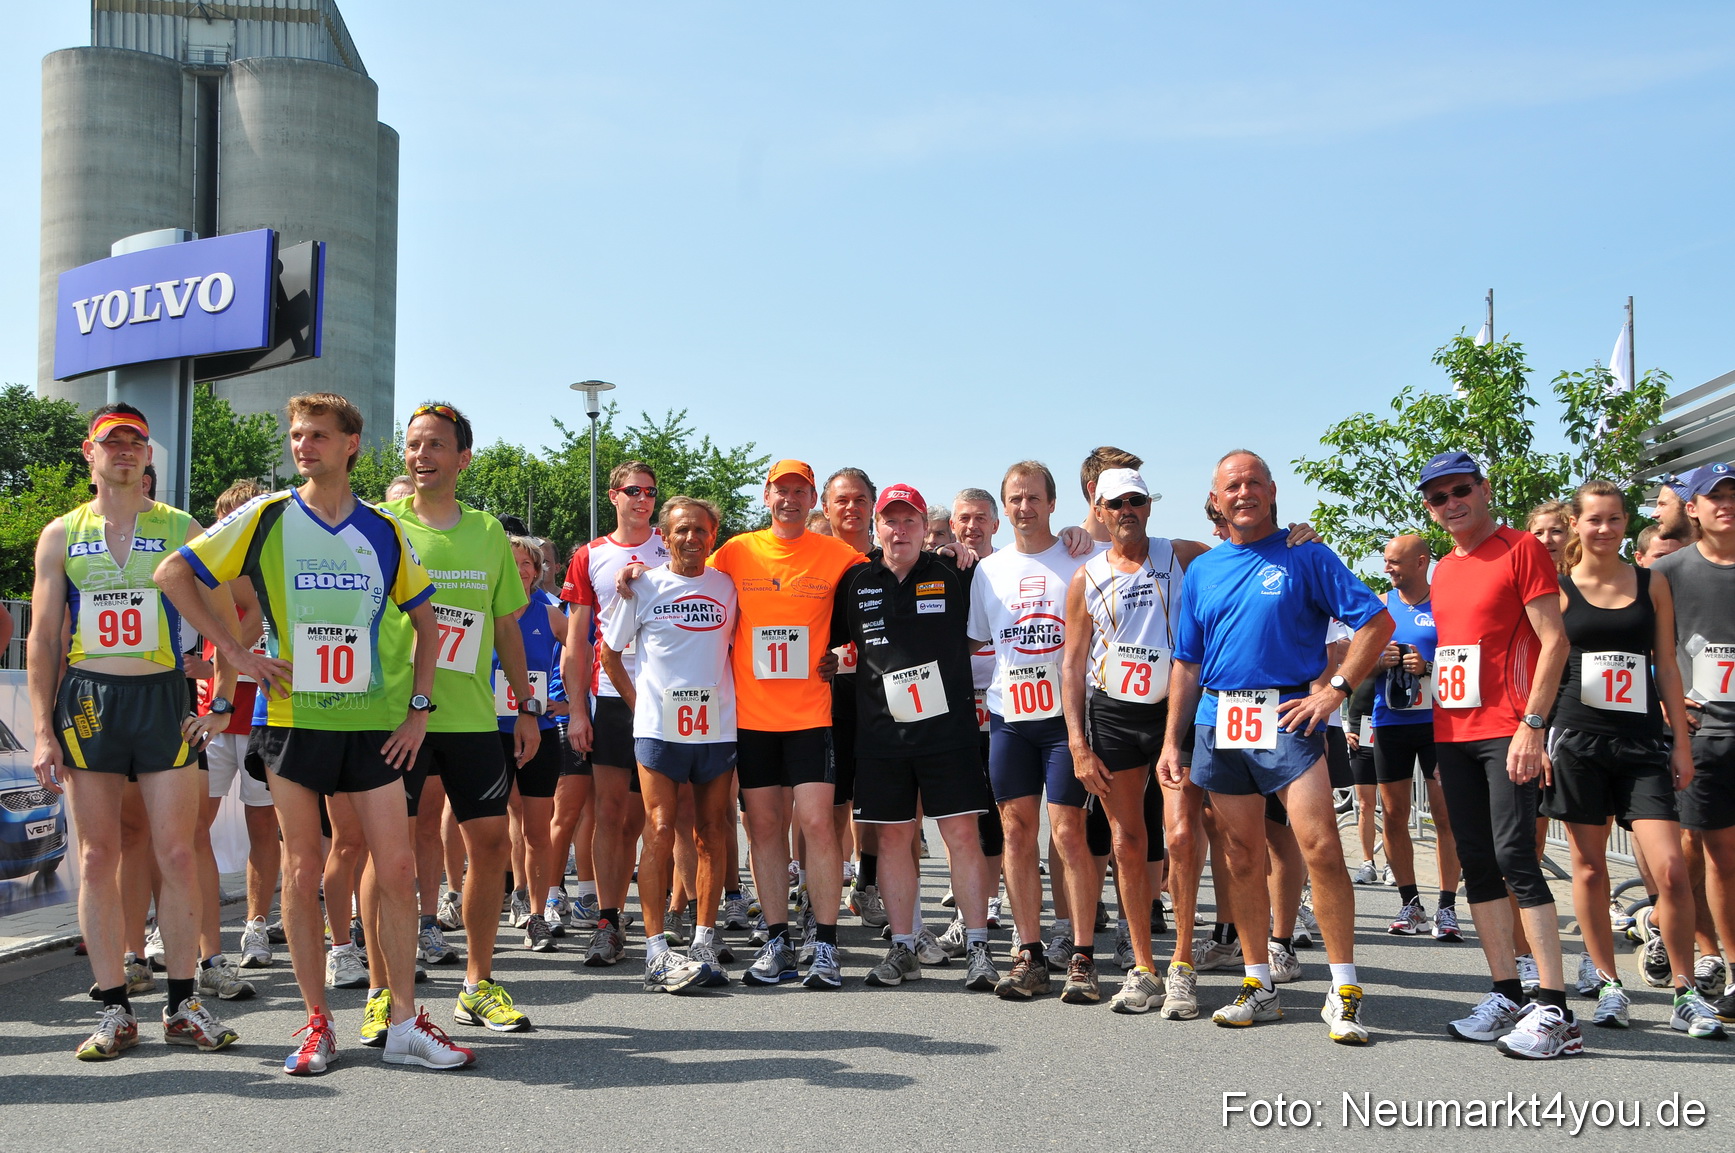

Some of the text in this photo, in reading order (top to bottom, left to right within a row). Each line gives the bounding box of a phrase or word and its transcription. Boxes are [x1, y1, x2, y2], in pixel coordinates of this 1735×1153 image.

[72, 271, 235, 334] VOLVO
[296, 559, 348, 571] TEAM
[426, 569, 487, 581] SUNDHEIT
[1154, 571, 1171, 580] asics
[294, 572, 371, 591] BOCK
[434, 582, 458, 590] ESTEN
[93, 592, 128, 602] MEYER
[432, 605, 463, 618] MEYER
[653, 603, 715, 615] GERHART
[1011, 600, 1054, 611] SEAT
[98, 608, 143, 648] 99
[307, 627, 343, 636] MEYER
[761, 629, 787, 637] MEYER
[999, 624, 1054, 639] GERHART
[307, 634, 344, 642] WERBUNG
[436, 623, 466, 663] 77
[1020, 633, 1062, 645] JÄNIG
[1117, 645, 1147, 655] MEYER
[1704, 646, 1735, 654] MEYER
[767, 642, 788, 672] 11
[1117, 652, 1147, 661] WERBUNG
[316, 644, 354, 685] 10
[892, 669, 918, 681] MEYER
[1009, 668, 1034, 676] MEYER
[1009, 673, 1035, 681] WERBUNG
[1717, 661, 1735, 694] 7
[893, 676, 920, 686] WERBUNG
[1120, 661, 1152, 697] 73
[1438, 664, 1466, 702] 58
[1601, 668, 1632, 704] 12
[907, 683, 923, 714] 1
[1009, 679, 1054, 715] 100
[1225, 690, 1253, 698] MEYER
[677, 704, 709, 736] 64
[1227, 706, 1263, 743] 85
[27, 823, 55, 836] VENGA
